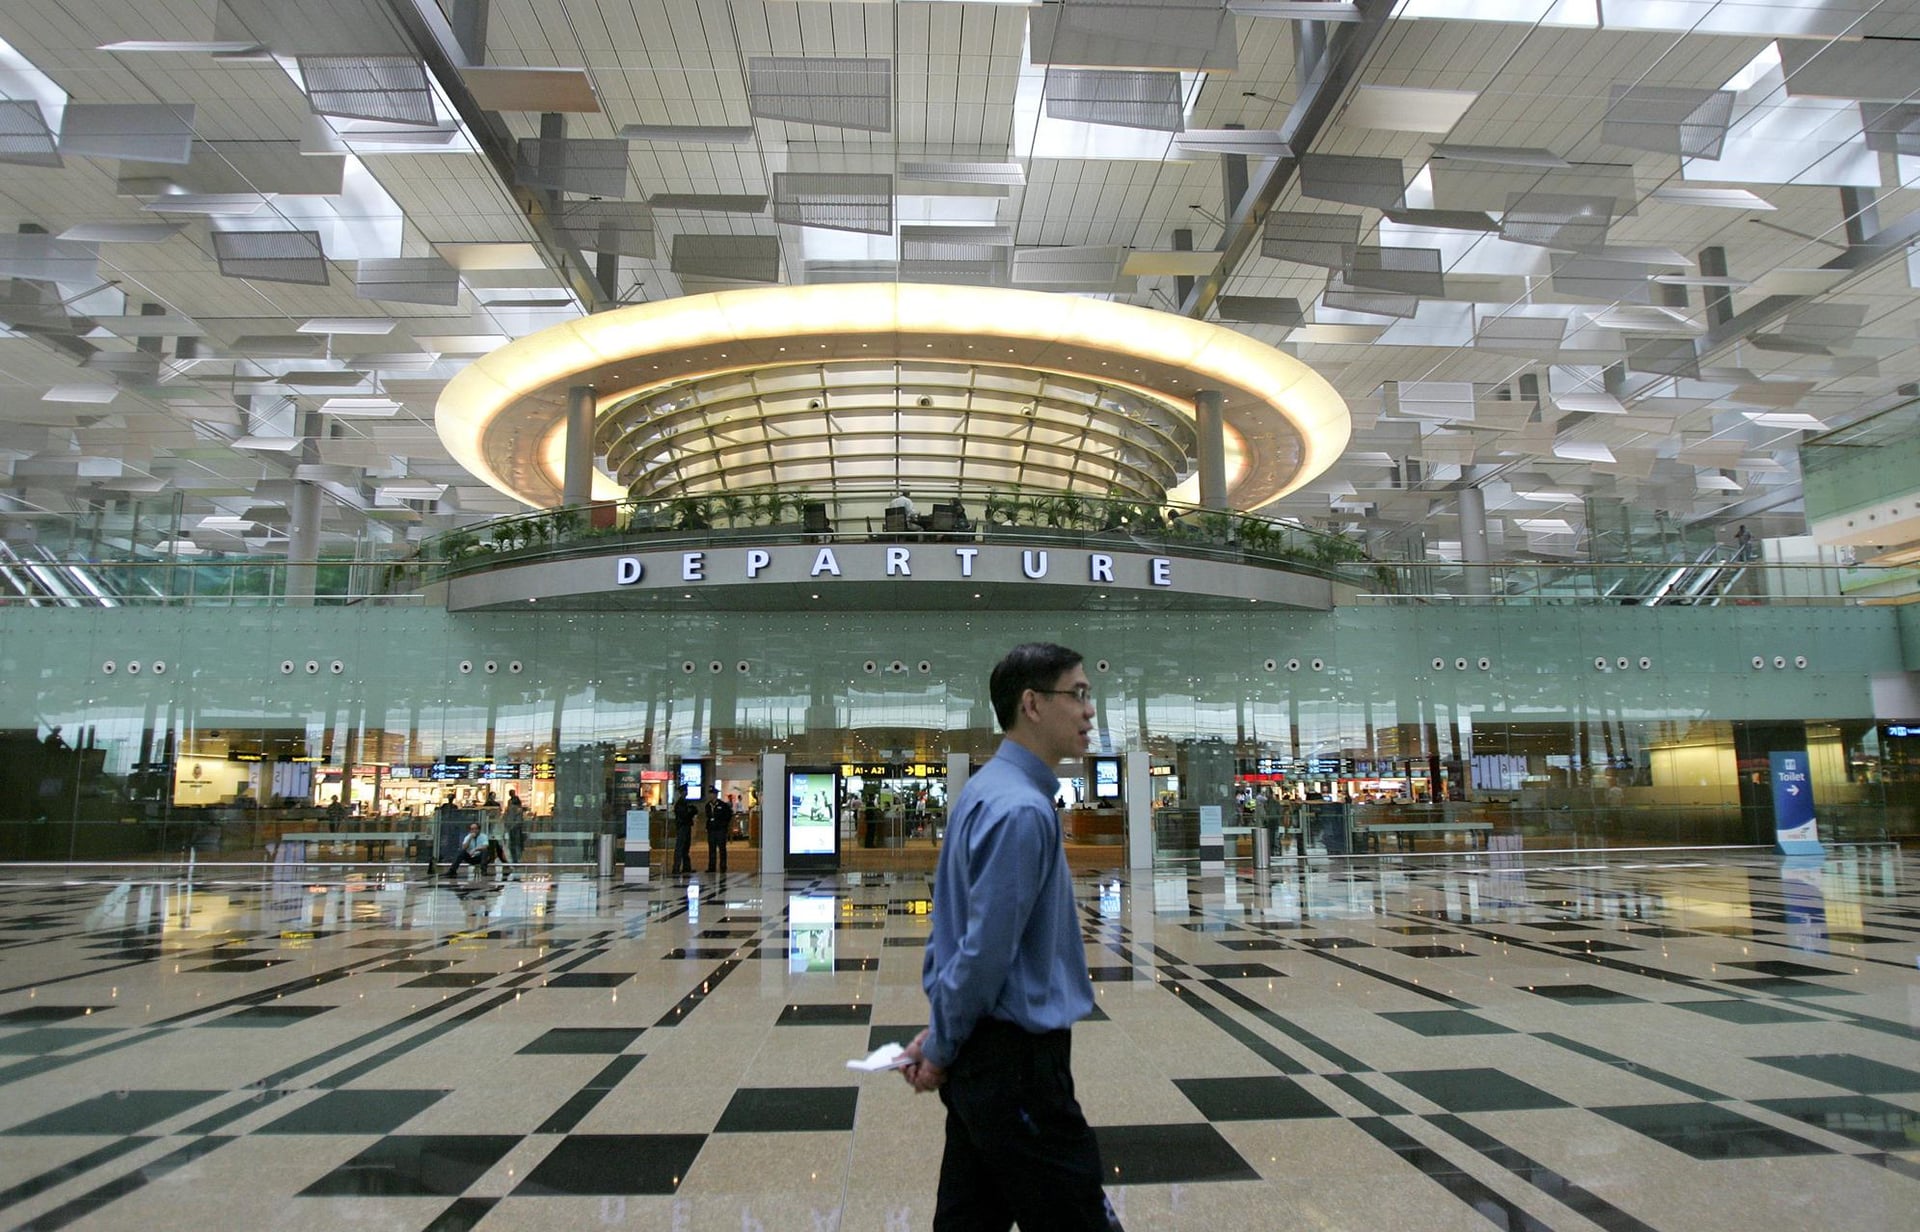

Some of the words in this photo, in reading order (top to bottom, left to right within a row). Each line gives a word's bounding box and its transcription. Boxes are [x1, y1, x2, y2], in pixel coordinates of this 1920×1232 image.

[617, 547, 1172, 586] DEPARTURE
[854, 766, 863, 775] A1
[871, 766, 885, 775] A21
[927, 766, 935, 775] B1
[1778, 771, 1805, 781] Toilet
